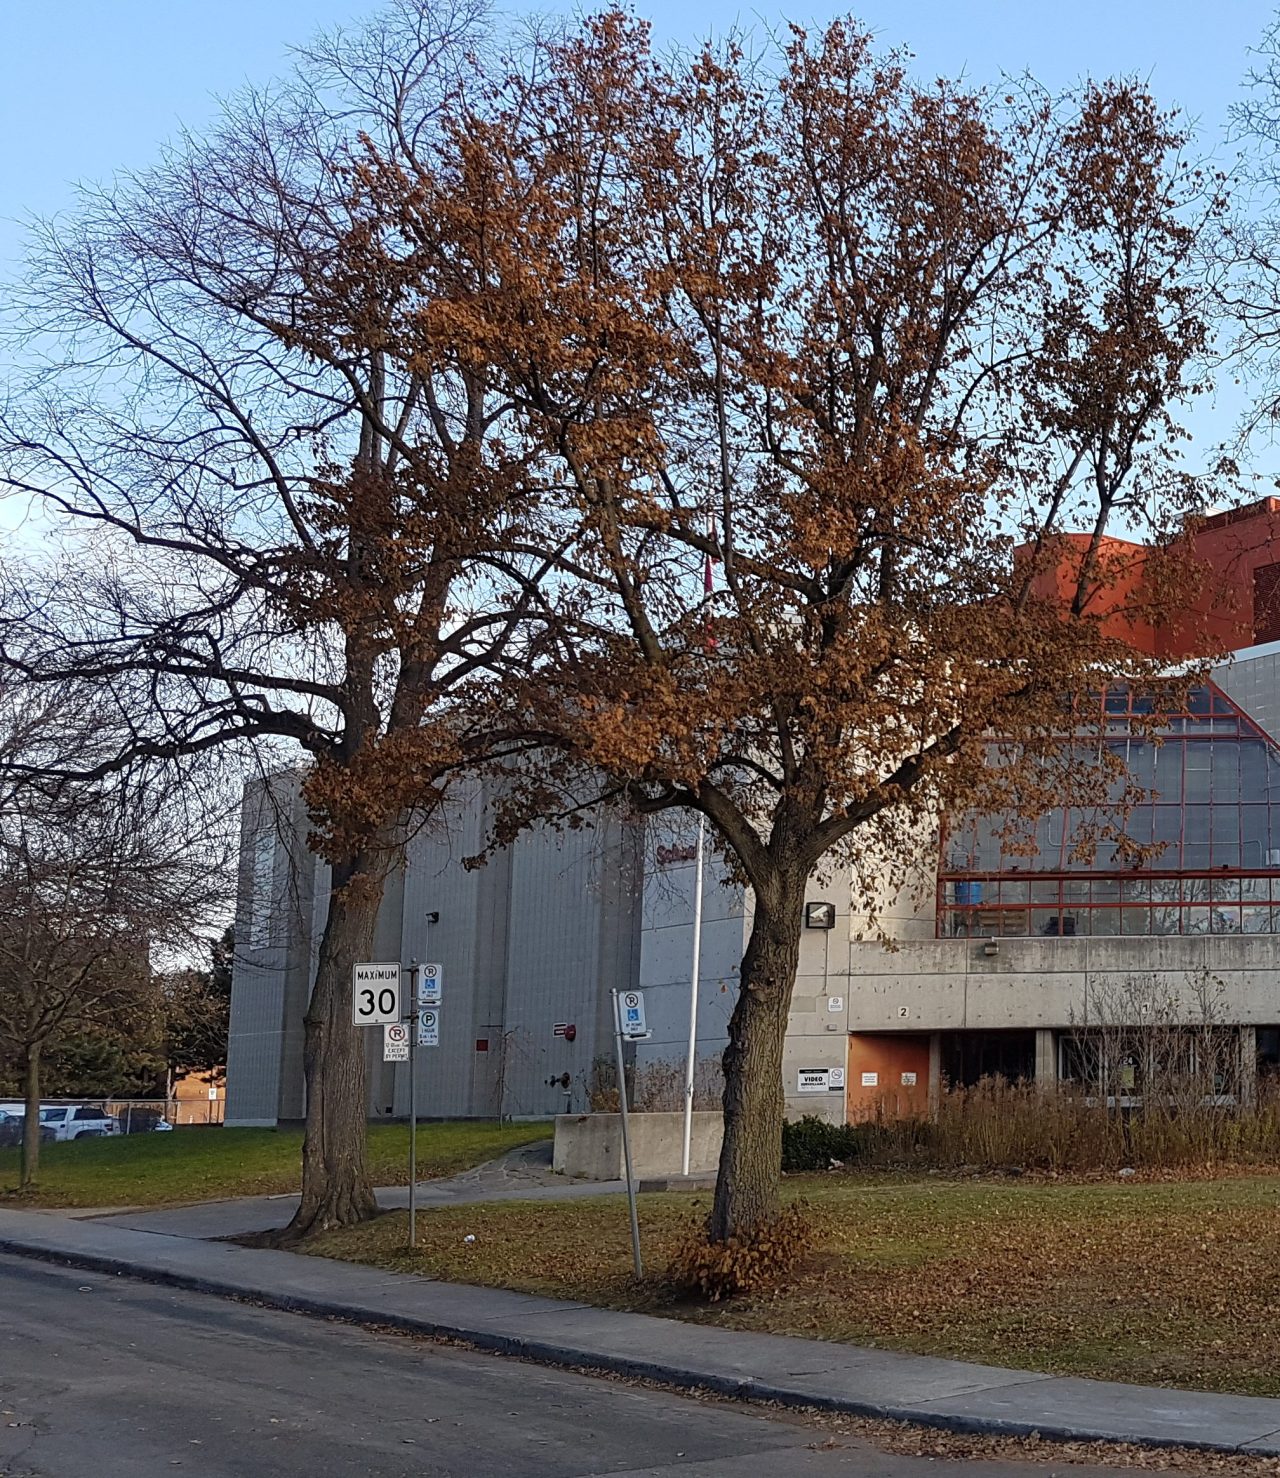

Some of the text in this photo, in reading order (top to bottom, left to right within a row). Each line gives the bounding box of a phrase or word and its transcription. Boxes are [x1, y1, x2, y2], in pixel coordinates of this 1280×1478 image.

[357, 970, 398, 980] MAXIMUM
[359, 988, 396, 1016] 30
[900, 1007, 907, 1017] 2
